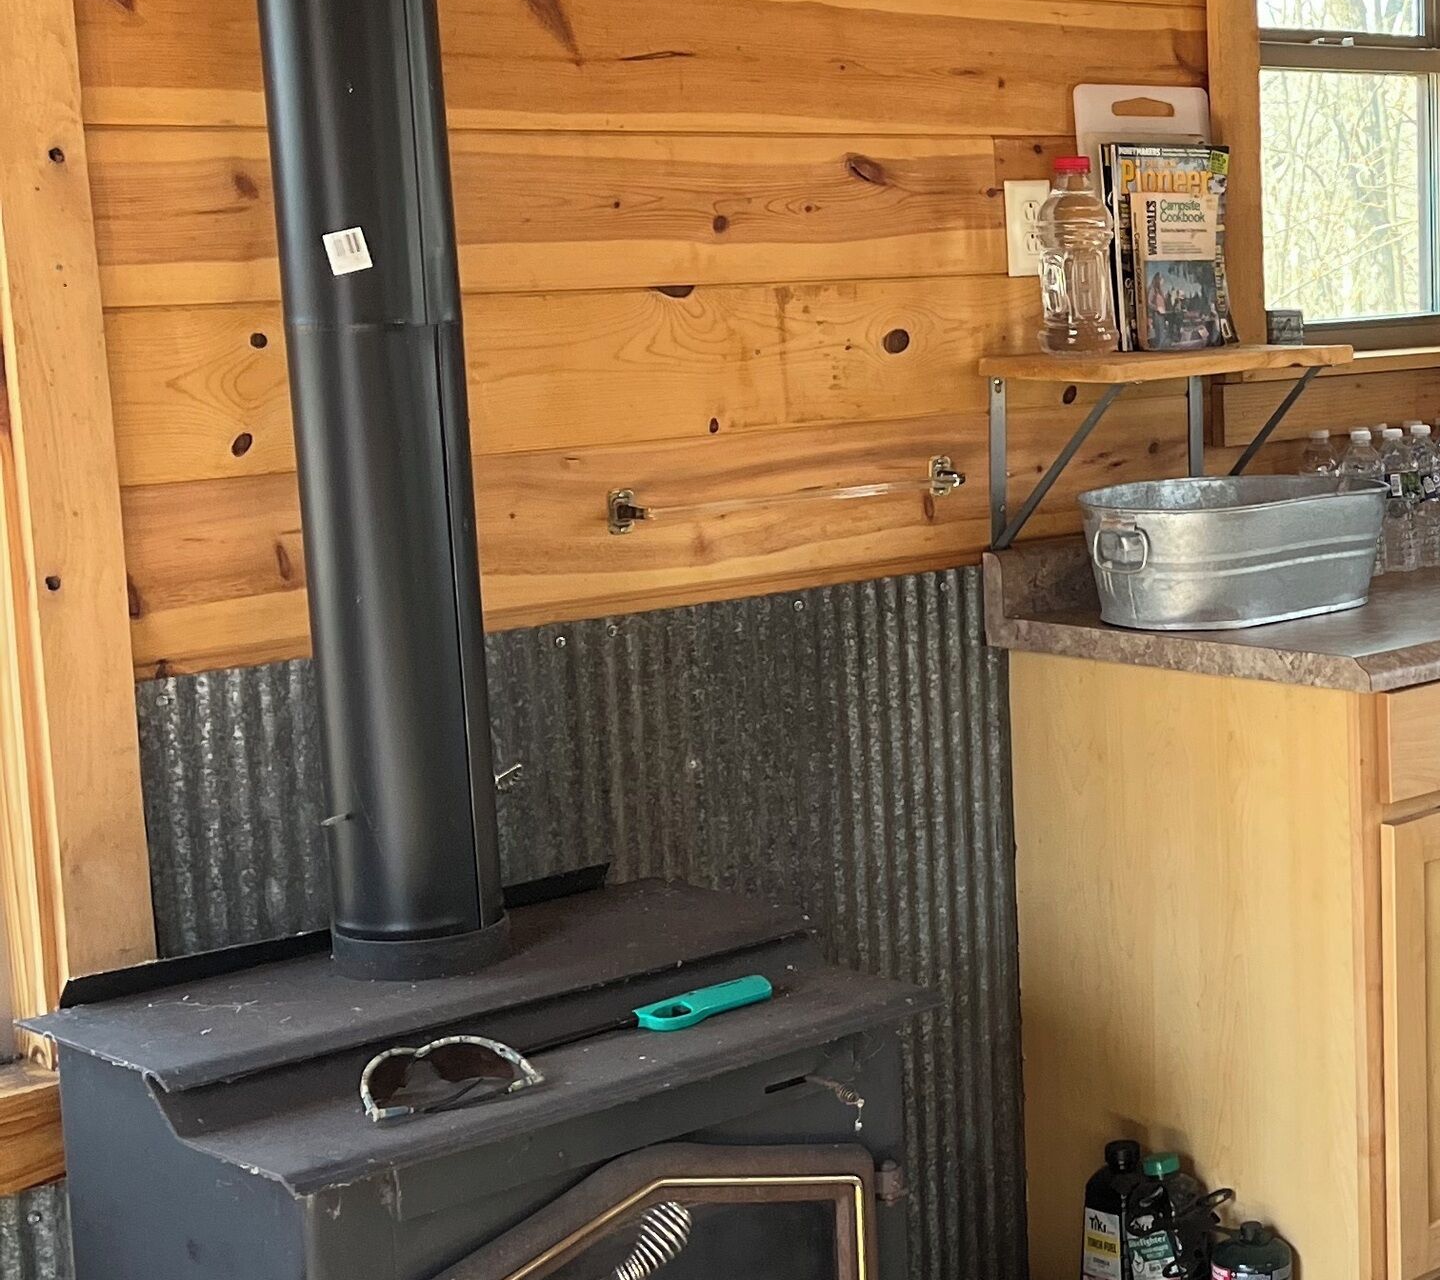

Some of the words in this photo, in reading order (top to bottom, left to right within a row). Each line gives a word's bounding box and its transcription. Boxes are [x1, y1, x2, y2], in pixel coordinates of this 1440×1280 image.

[1120, 159, 1212, 195] Pioneer
[1160, 199, 1201, 214] Campsite
[1160, 211, 1206, 223] Cookbook
